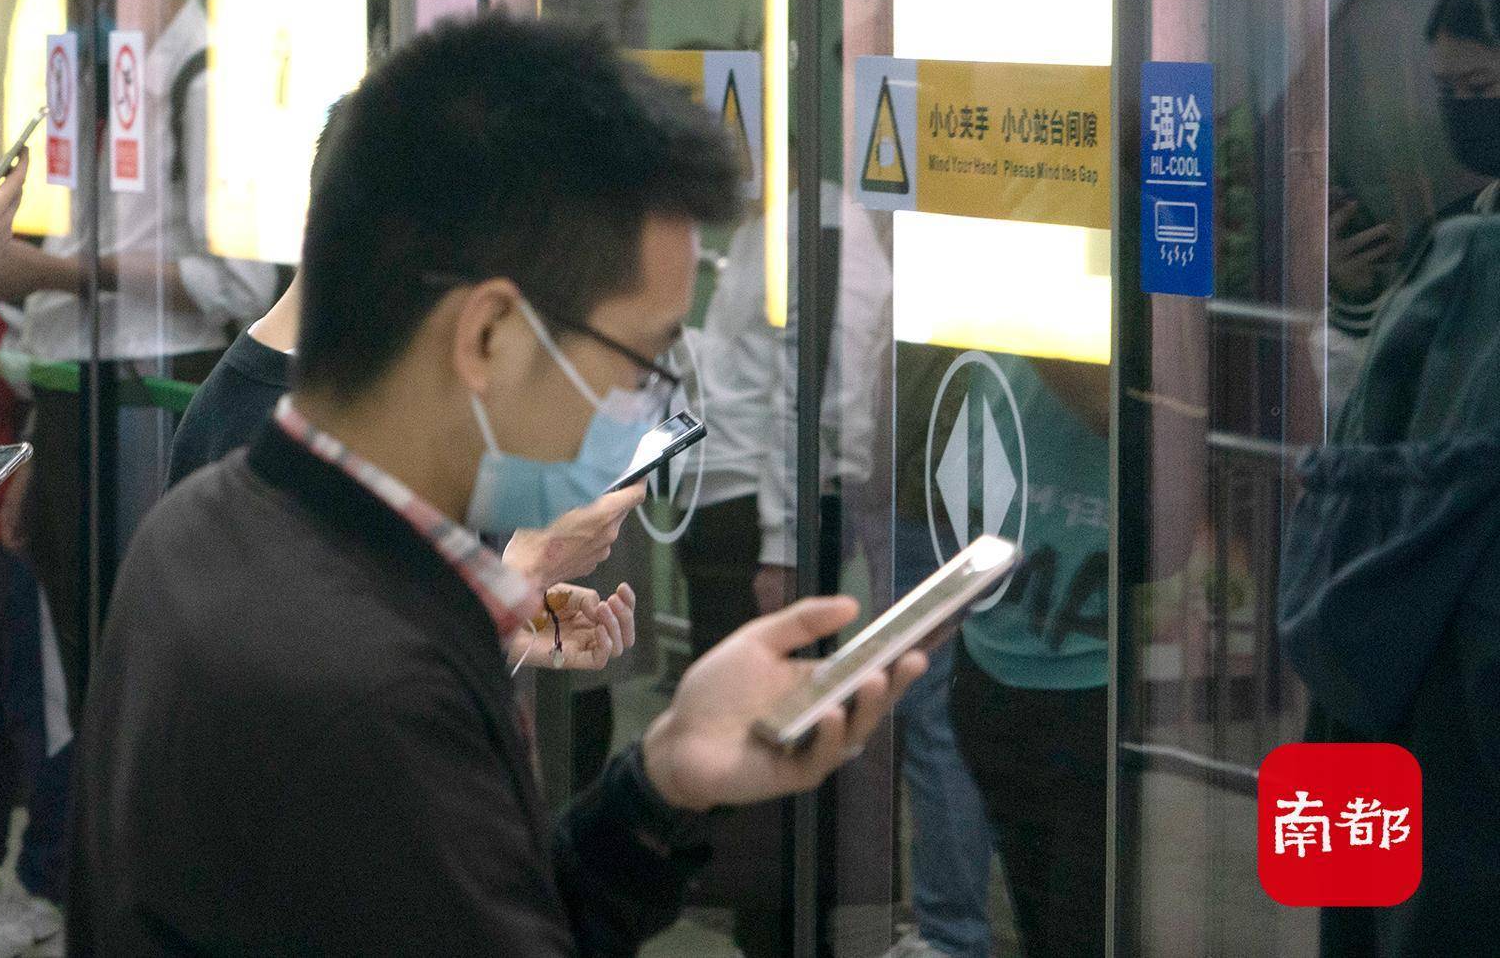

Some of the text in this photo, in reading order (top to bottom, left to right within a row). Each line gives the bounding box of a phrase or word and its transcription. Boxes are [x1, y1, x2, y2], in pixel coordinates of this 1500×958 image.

[929, 103, 1098, 147] 小心夹手 小心站台间隙
[1151, 94, 1201, 151] 强冷
[1004, 160, 1035, 179] Please
[1037, 162, 1060, 180] Mind
[1079, 165, 1098, 187] Gap
